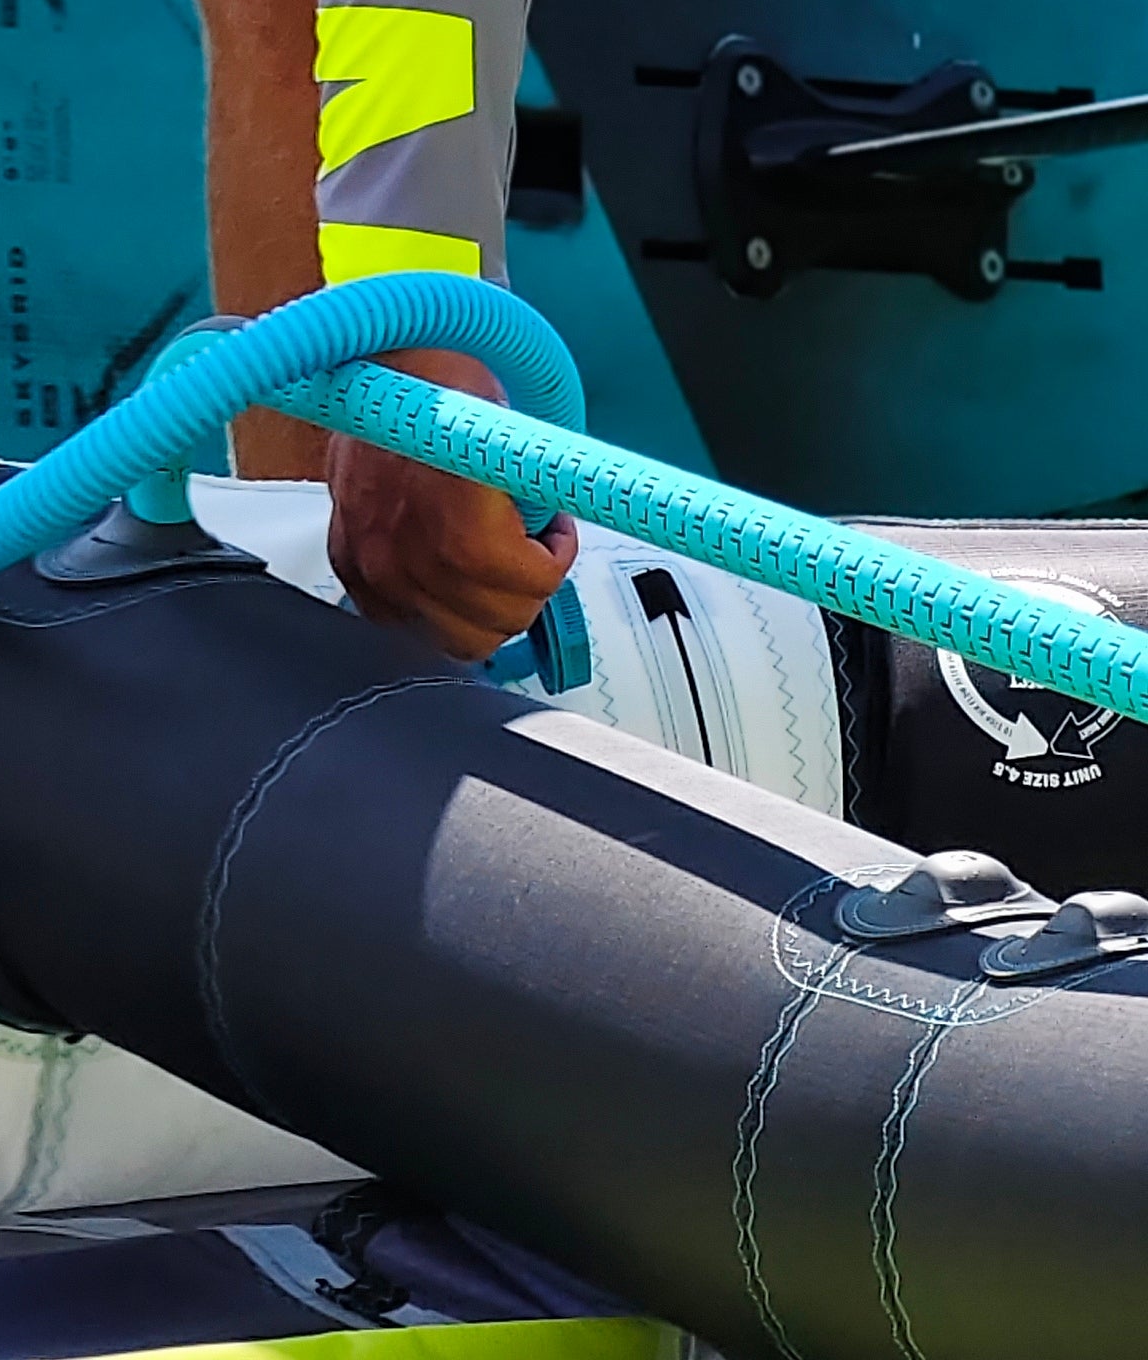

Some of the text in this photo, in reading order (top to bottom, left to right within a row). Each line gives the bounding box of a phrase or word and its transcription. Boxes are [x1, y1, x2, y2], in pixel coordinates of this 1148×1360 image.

[993, 762, 1102, 788] UNIT SIZE 4.5
